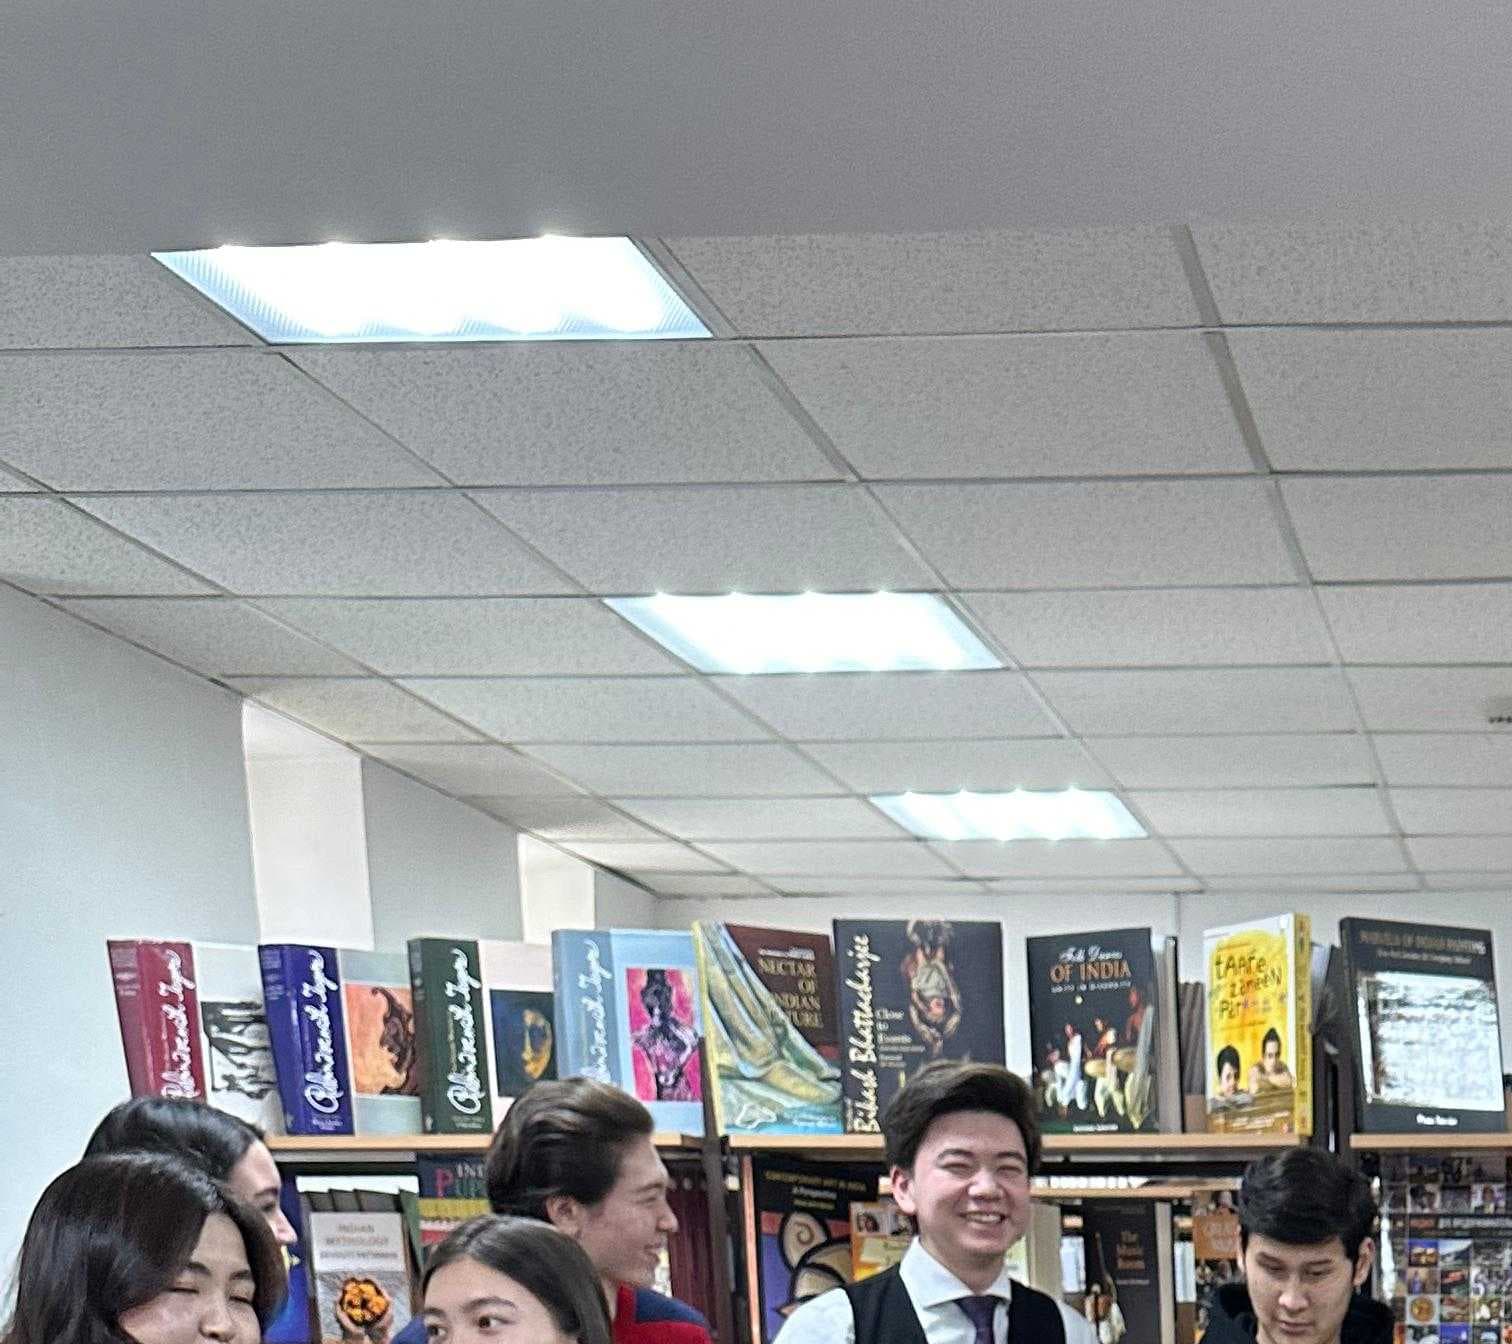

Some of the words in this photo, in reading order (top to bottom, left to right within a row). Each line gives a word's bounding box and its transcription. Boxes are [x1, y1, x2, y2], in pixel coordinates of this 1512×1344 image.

[1049, 962, 1073, 984] OF
[1079, 960, 1132, 983] INDIA
[850, 1066, 880, 1132] Bikash
